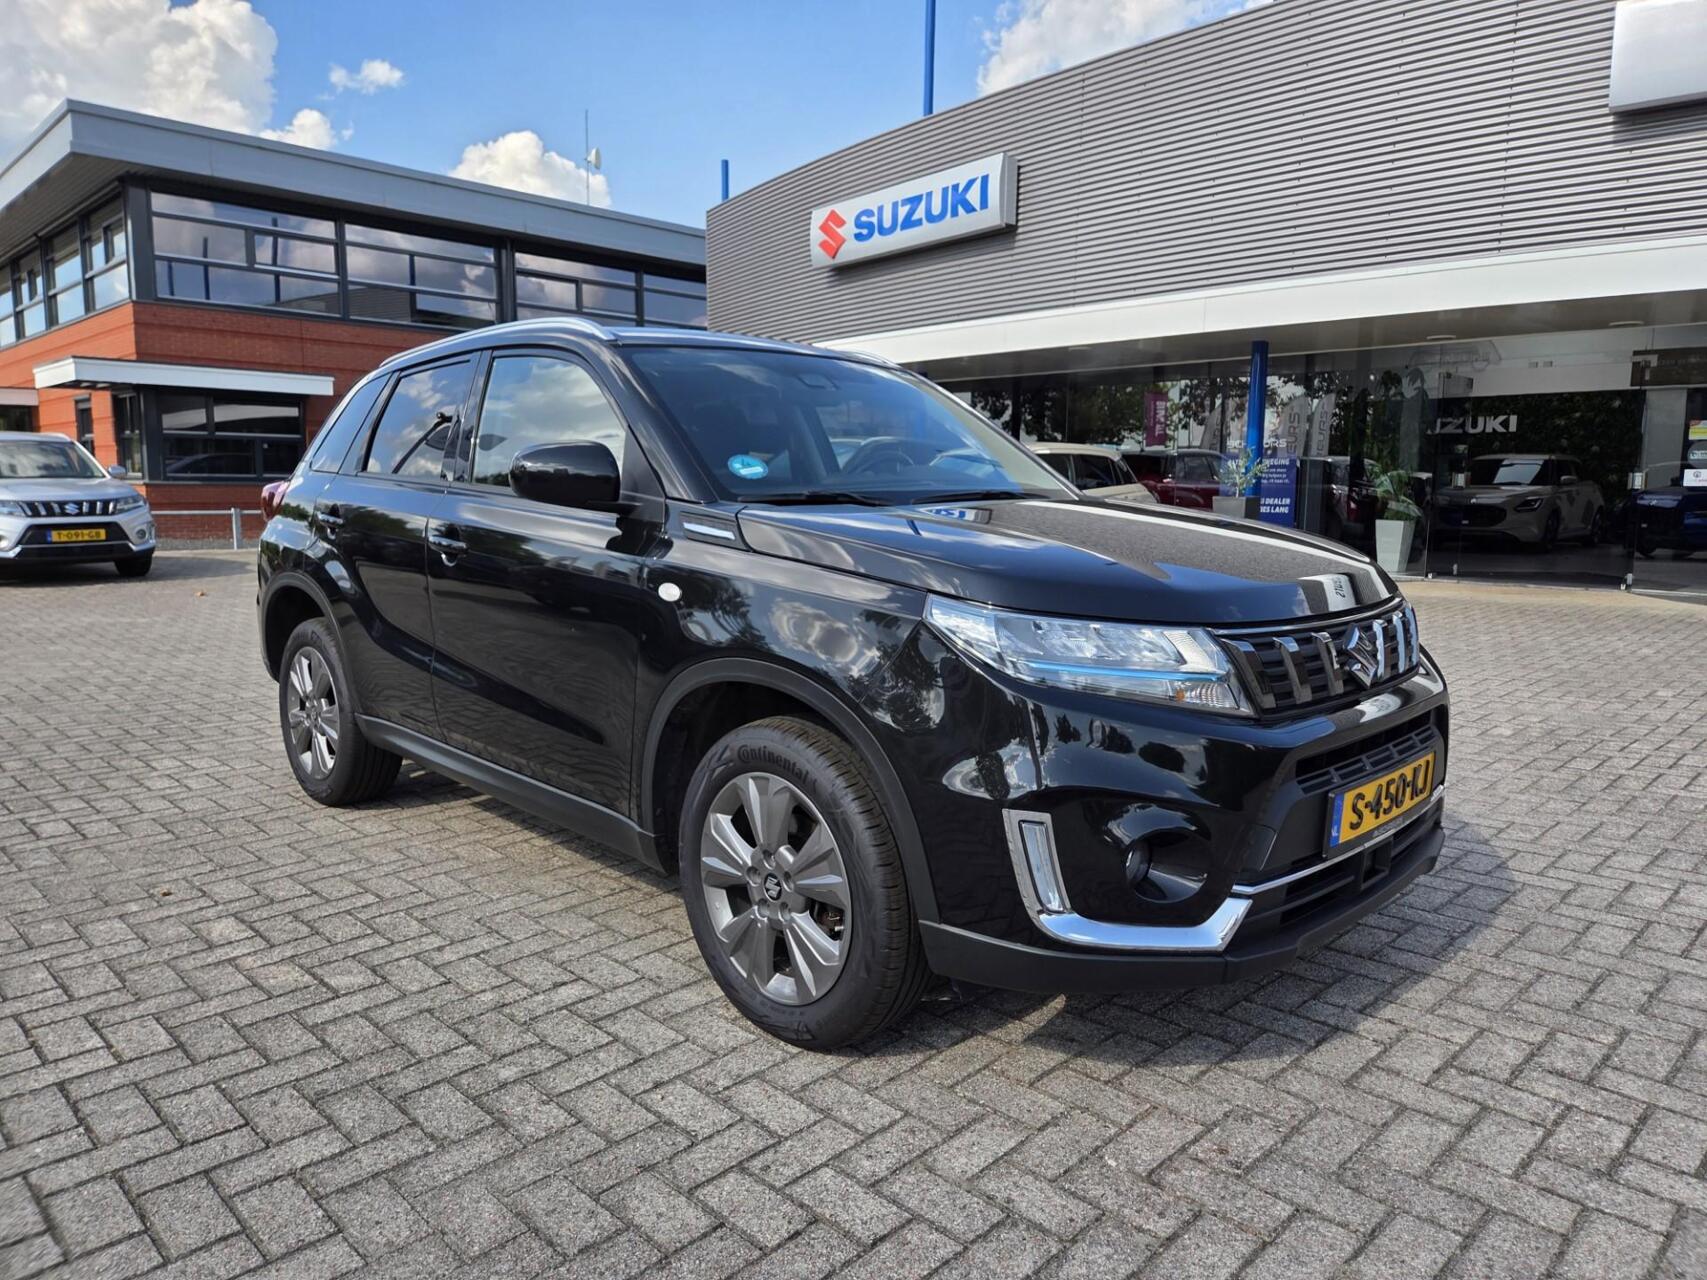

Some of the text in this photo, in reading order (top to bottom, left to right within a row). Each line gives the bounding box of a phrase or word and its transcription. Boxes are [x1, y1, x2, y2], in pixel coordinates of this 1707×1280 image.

[853, 173, 990, 242] SUZUKI
[1265, 497, 1291, 505] DEALER
[1270, 506, 1289, 514] LANG
[737, 743, 810, 785] Continental
